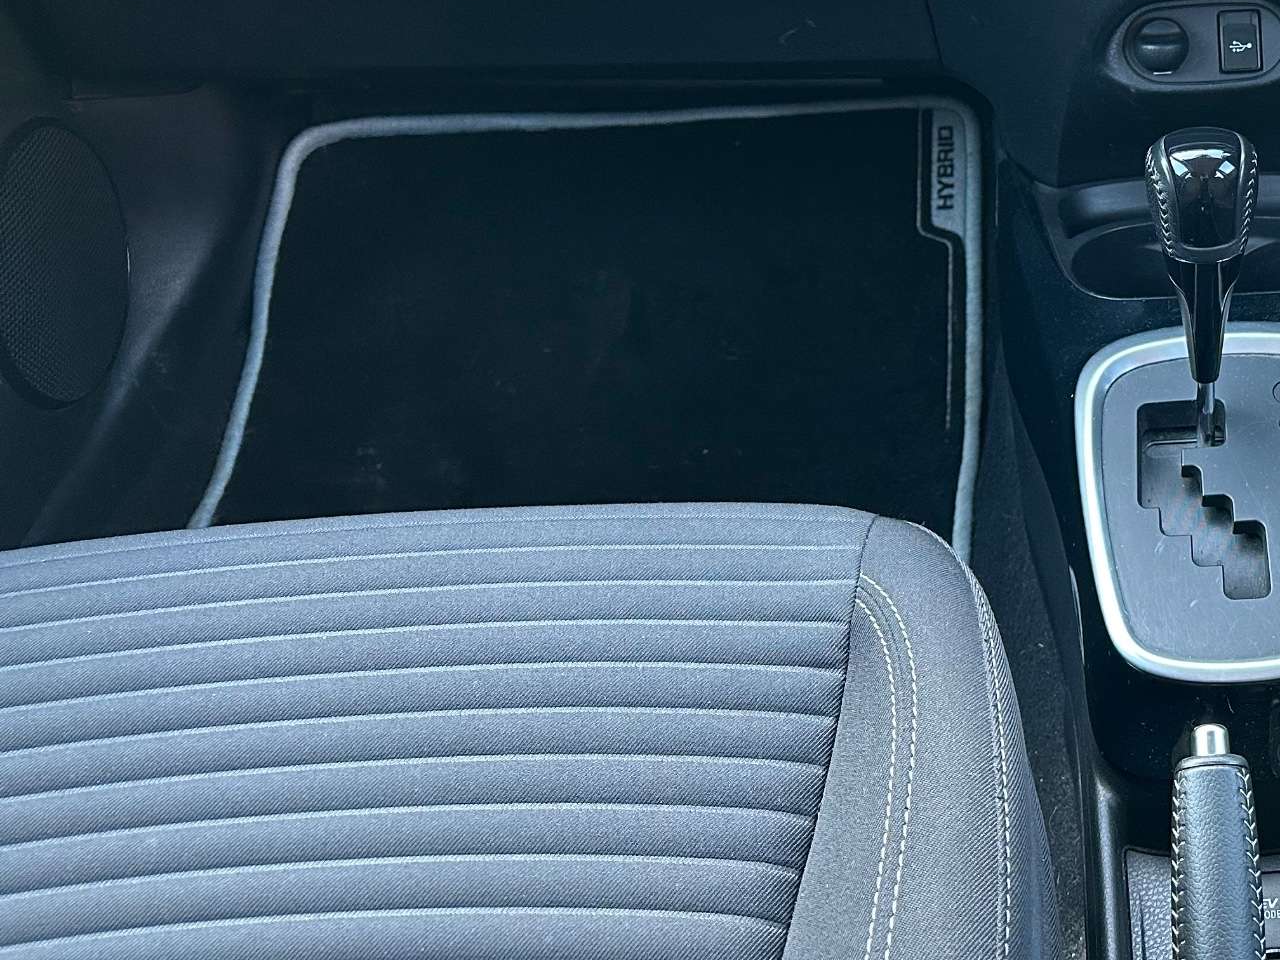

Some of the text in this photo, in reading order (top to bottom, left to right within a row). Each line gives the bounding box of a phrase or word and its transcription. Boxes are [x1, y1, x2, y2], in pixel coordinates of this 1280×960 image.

[937, 126, 954, 210] HYBRID
[1262, 897, 1279, 909] EV
[1263, 909, 1280, 920] ODE
